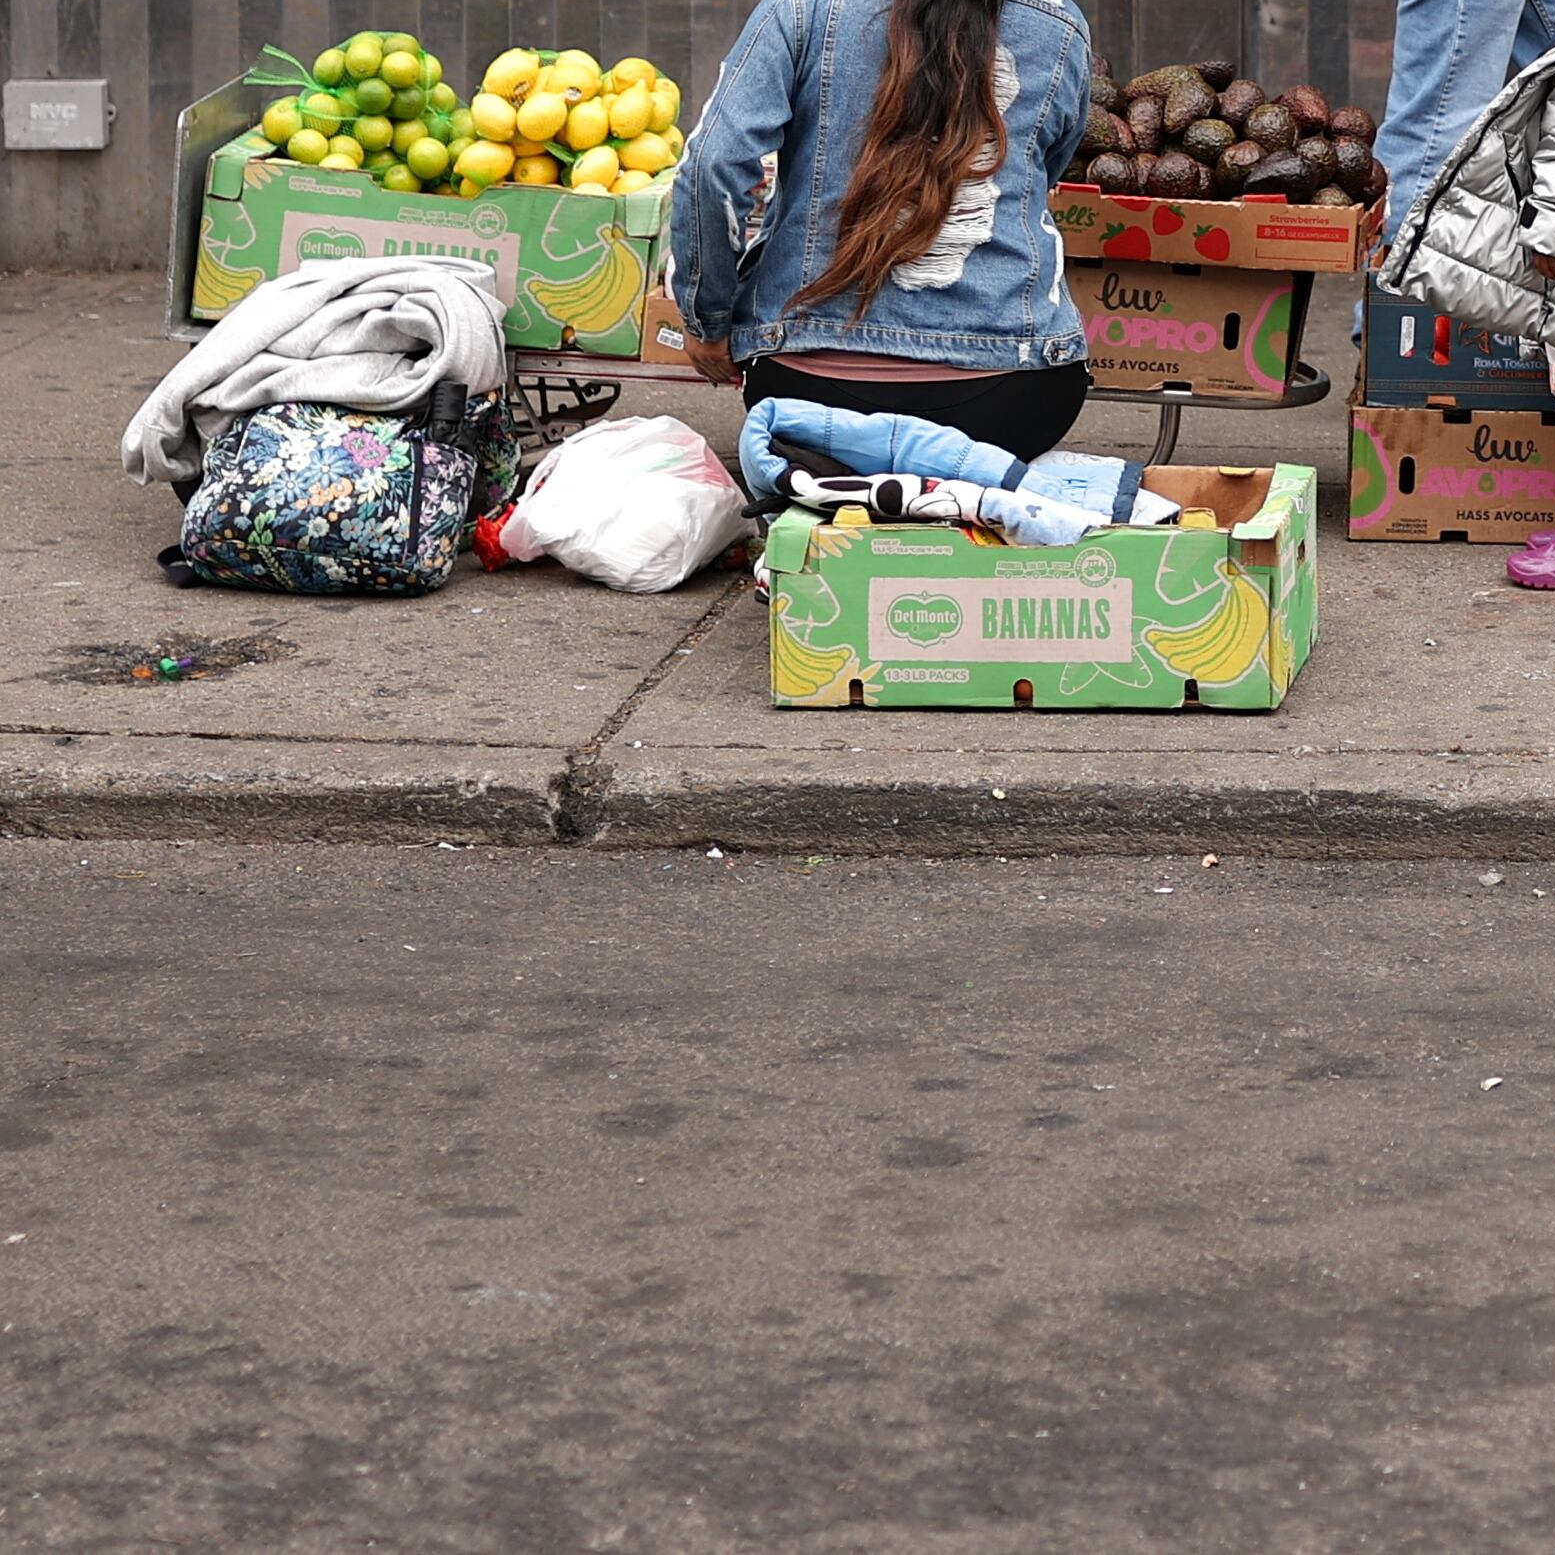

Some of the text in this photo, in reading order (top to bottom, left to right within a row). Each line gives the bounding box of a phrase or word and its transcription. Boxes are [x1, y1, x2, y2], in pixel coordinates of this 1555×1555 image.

[1054, 204, 1098, 228] oll's
[1269, 214, 1330, 226] Strawberries
[1264, 227, 1286, 237] 8-16
[303, 240, 321, 254] Del
[1083, 313, 1217, 354] VOPRO
[1118, 359, 1180, 374] AVOCATS
[1466, 424, 1538, 464] luv
[1456, 510, 1554, 523] HASS AVOCATS
[893, 608, 958, 625] Del Monte
[981, 597, 1112, 640] BANANAS
[886, 670, 967, 681] 13-3 LB PACKS
